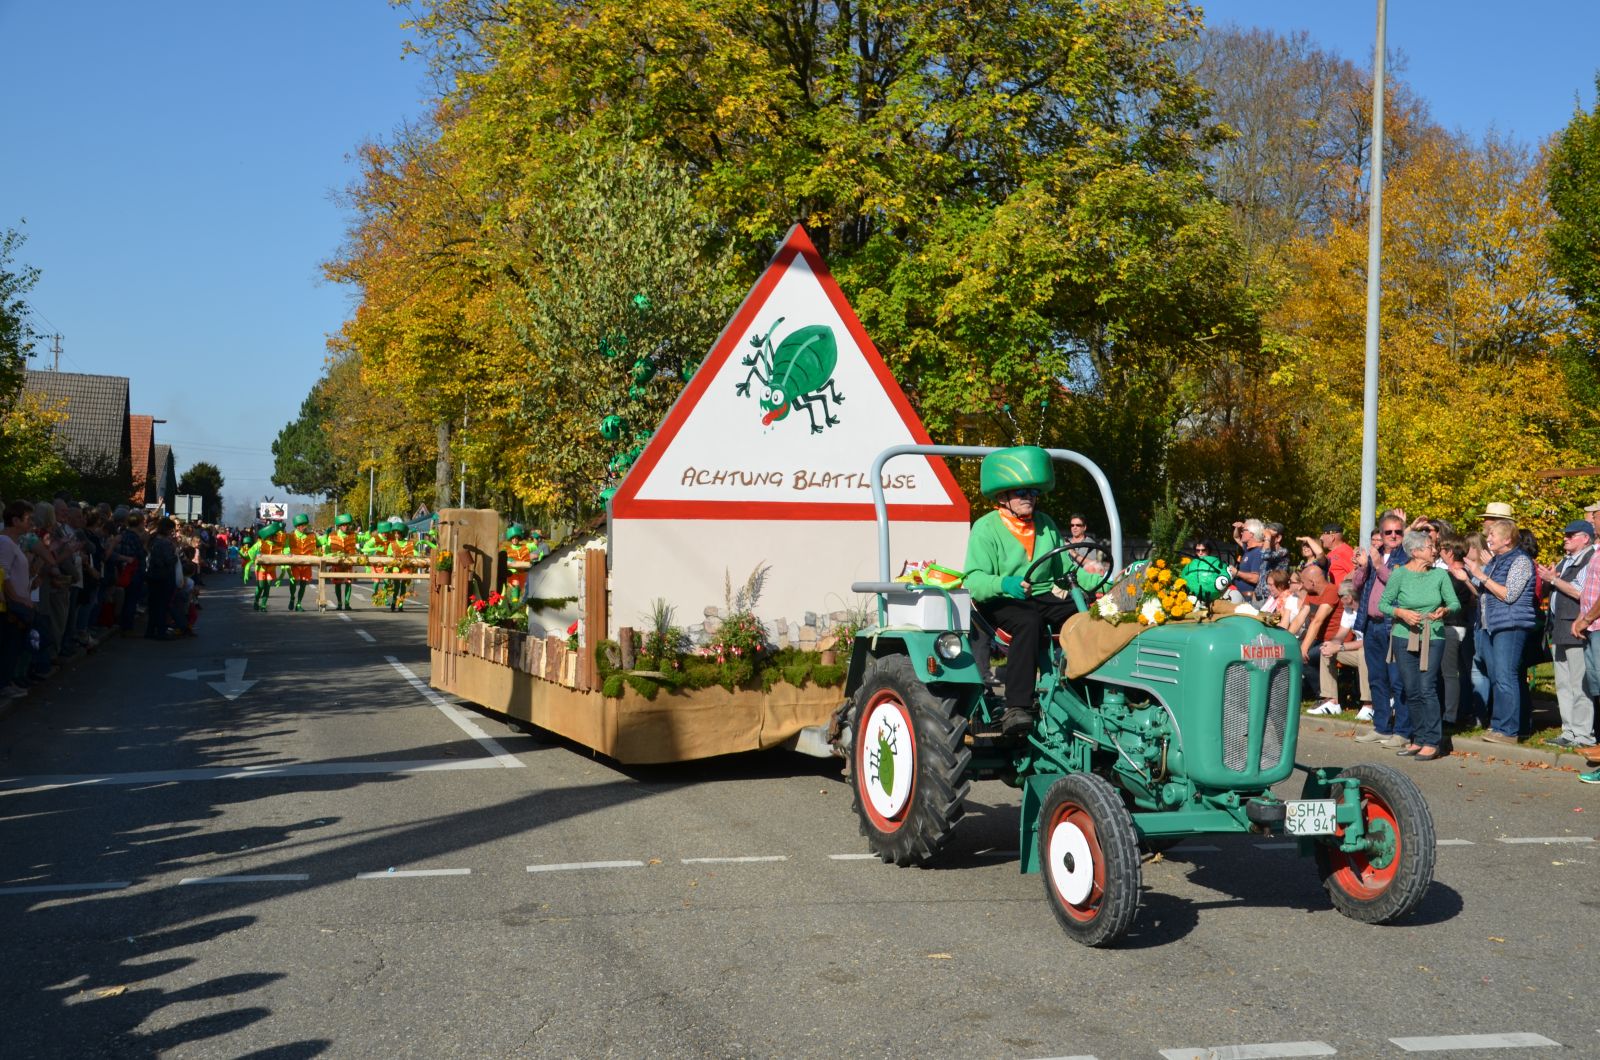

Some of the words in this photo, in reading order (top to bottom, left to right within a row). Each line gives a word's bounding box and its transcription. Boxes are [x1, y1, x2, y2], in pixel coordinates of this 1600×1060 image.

[681, 467, 783, 487] ACHTUNG
[793, 469, 916, 490] BLATTLUSE
[1297, 803, 1326, 817] SHA
[1288, 819, 1306, 832] SK
[1313, 817, 1335, 832] 941
